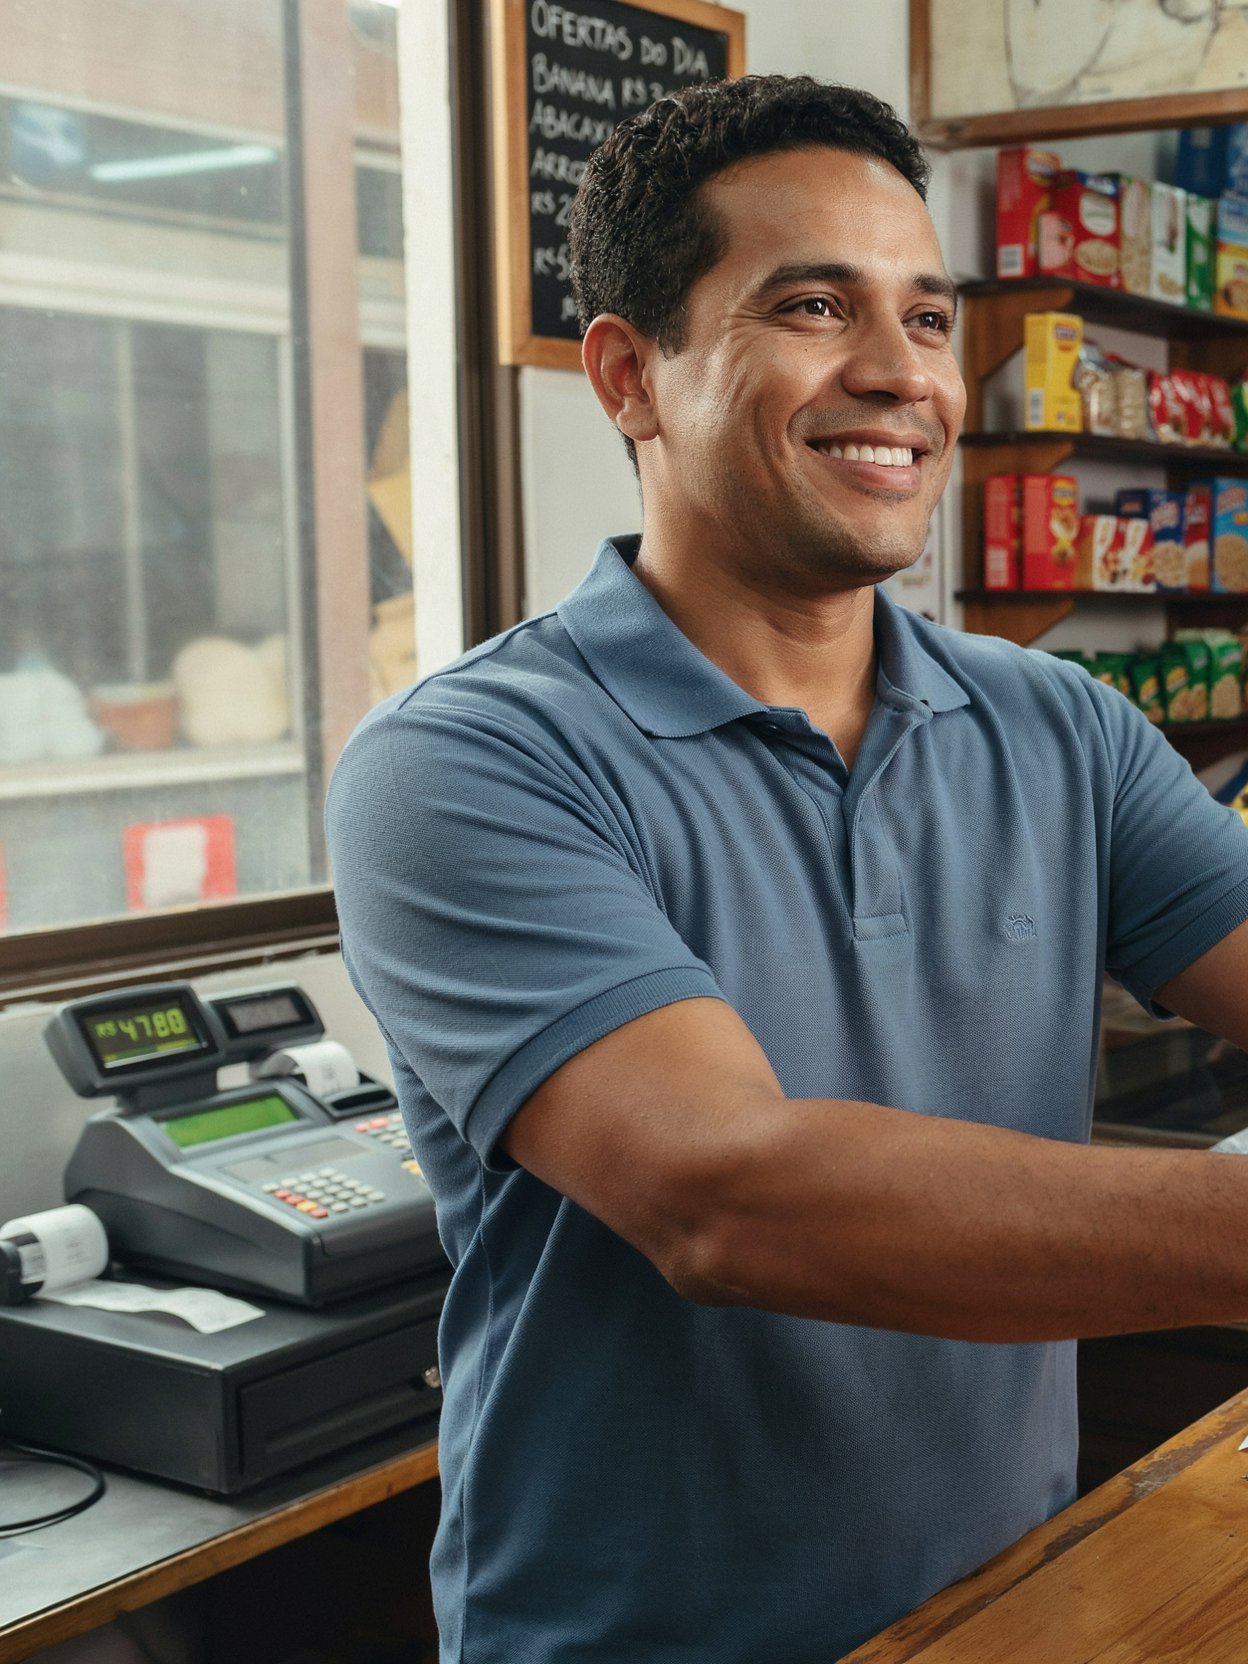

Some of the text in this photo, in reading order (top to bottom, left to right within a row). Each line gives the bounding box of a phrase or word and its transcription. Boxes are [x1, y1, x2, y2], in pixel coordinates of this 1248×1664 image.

[531, 0, 633, 60] OFERTAS
[671, 36, 710, 79] DIA
[532, 53, 617, 111] BANANA
